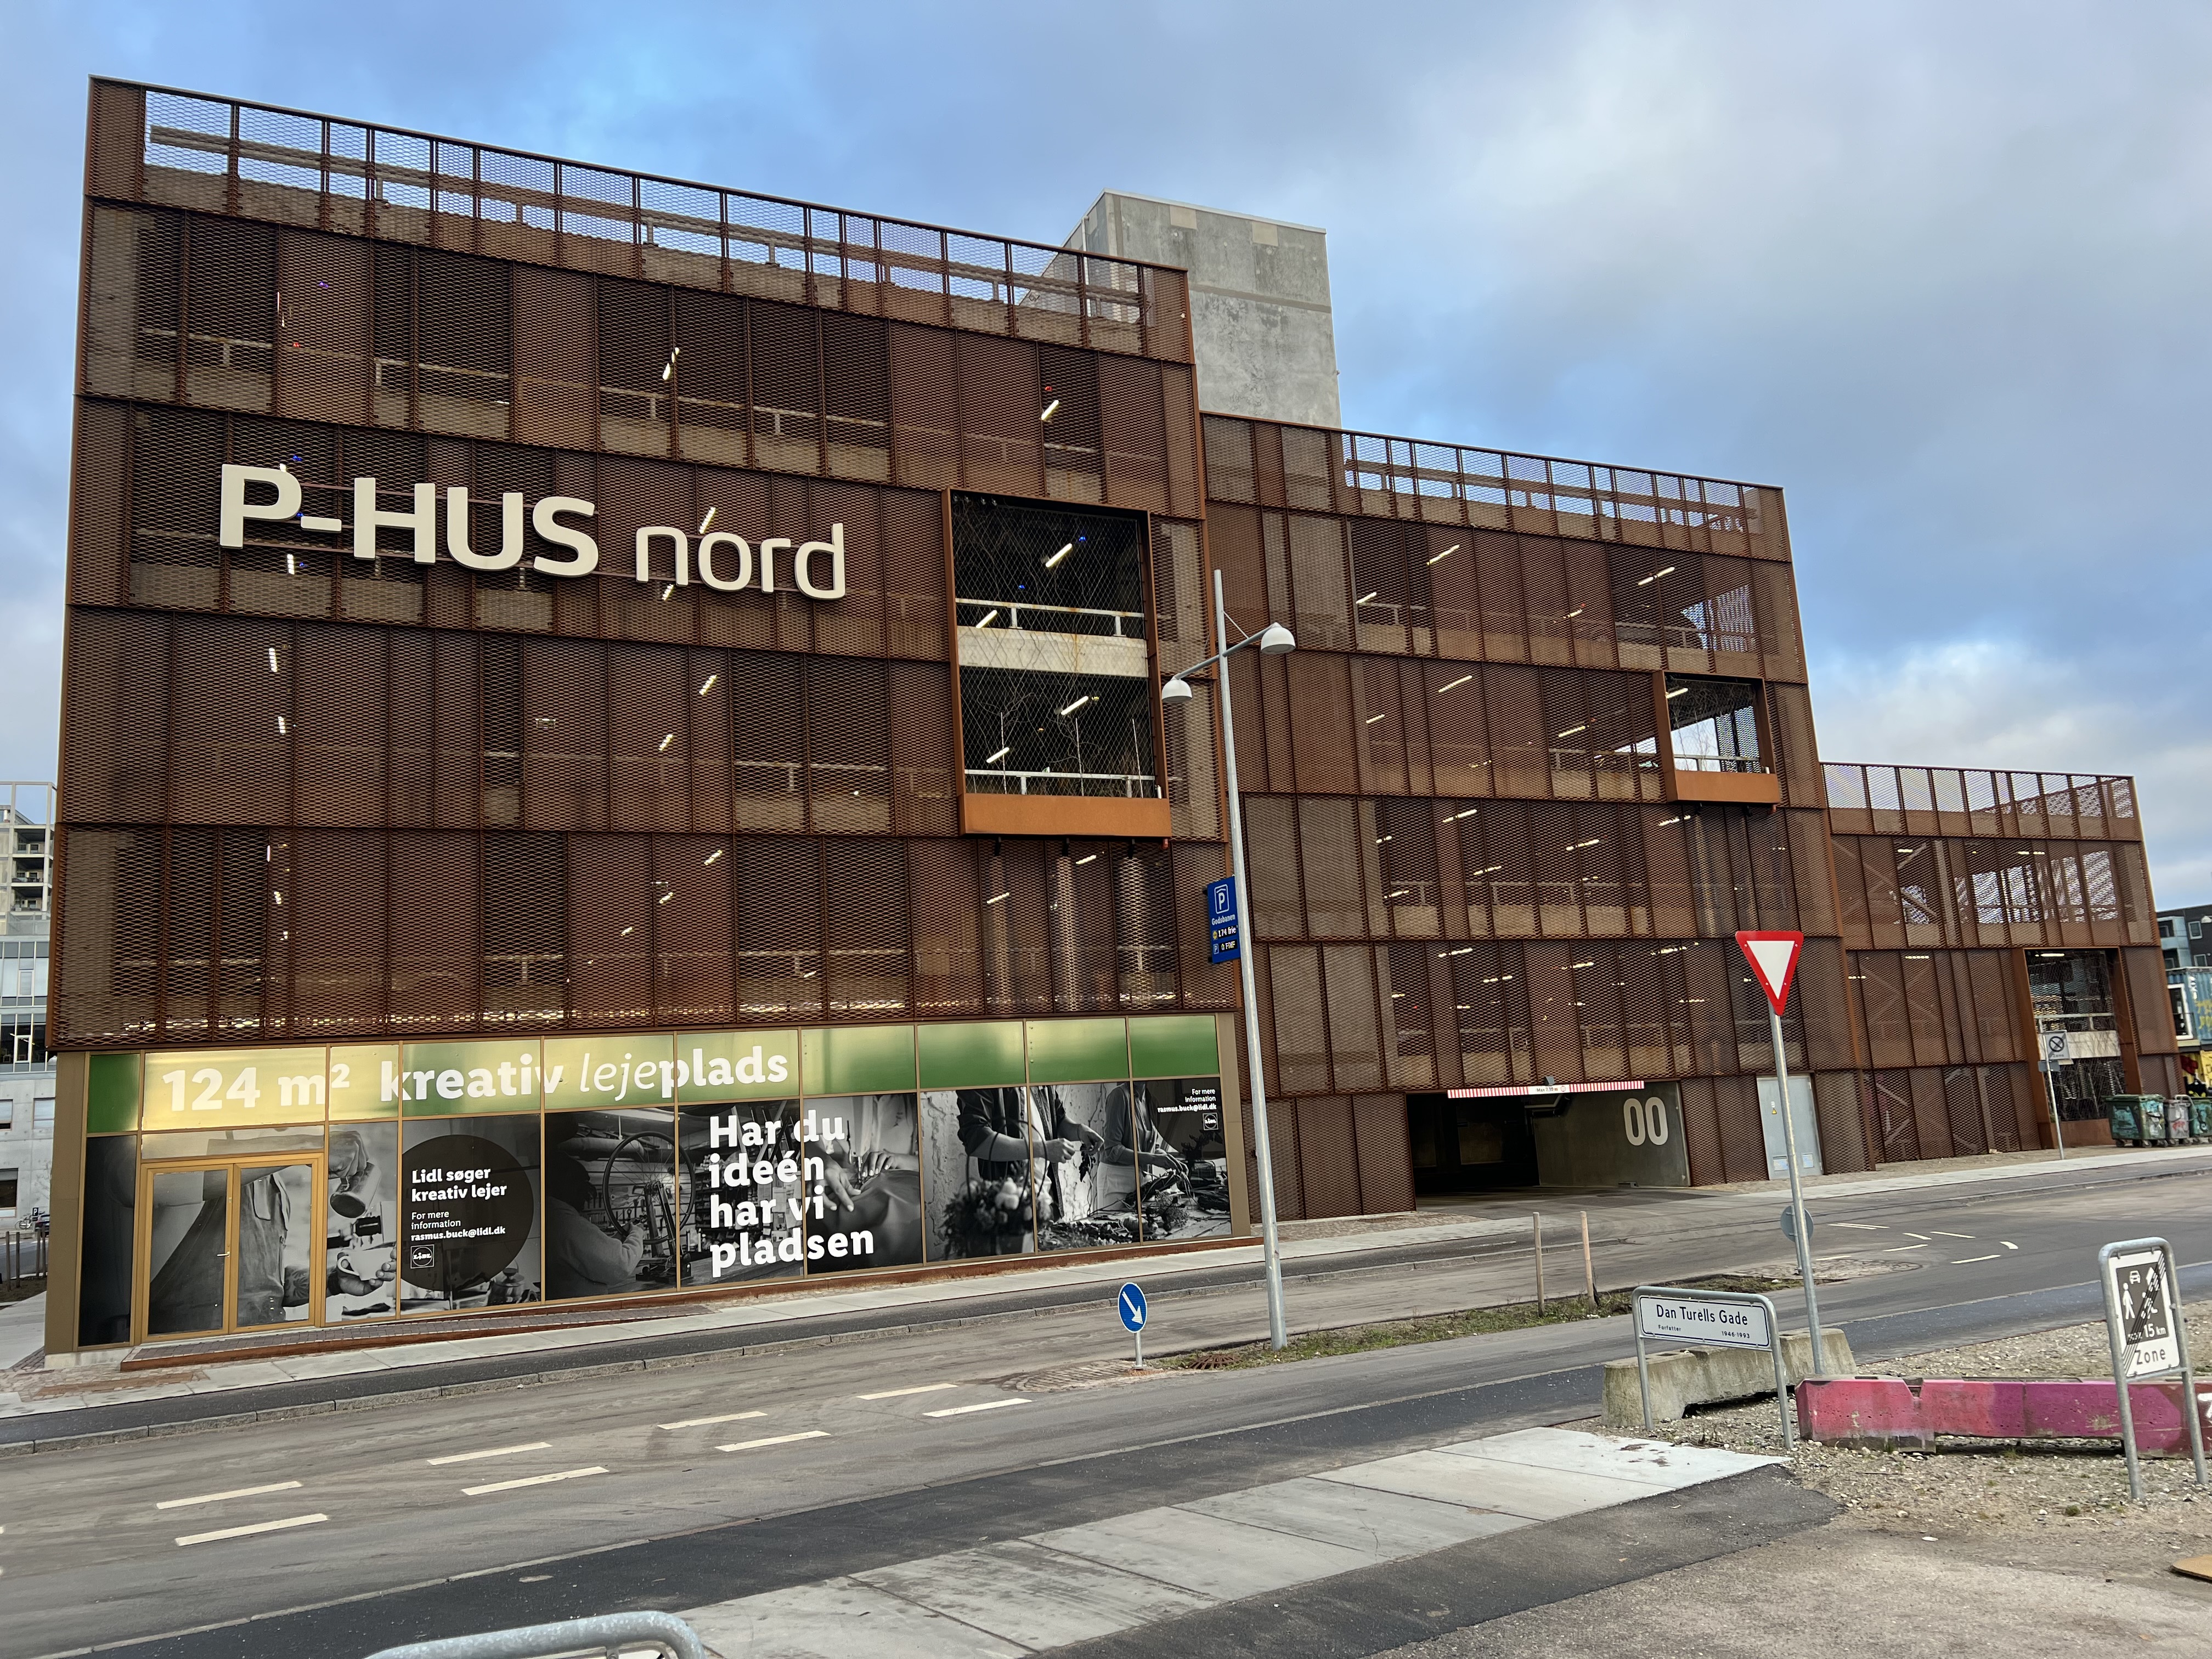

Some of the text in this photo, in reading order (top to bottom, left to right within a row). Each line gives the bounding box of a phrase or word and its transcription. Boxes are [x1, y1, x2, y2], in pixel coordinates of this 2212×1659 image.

[220, 463, 846, 600] P-HUS nord
[1211, 914, 1235, 926] Godsbanen
[1218, 928, 1227, 937] 174
[162, 1067, 261, 1112] 124
[380, 1053, 564, 1102] kreativ
[579, 1046, 788, 1102] lejeplads
[1157, 1103, 1217, 1113] rasmus.buck@lidl.dk
[710, 1109, 845, 1148] Har du
[1623, 1097, 1668, 1147] 00
[412, 1168, 491, 1183] Lidl søger
[709, 1150, 824, 1188] ideén
[411, 1183, 507, 1201] kreativ lejer
[710, 1185, 823, 1228] har vi
[411, 1220, 461, 1229] information
[411, 1226, 506, 1241] rasmus.buck@lidl.dk
[710, 1227, 874, 1278] pladsen
[1656, 1304, 1677, 1318] Dan
[1719, 1310, 1748, 1325] Gade
[1722, 1330, 1750, 1339] 1946-1993
[2144, 1323, 2155, 1338] 15
[2156, 1326, 2166, 1335] km
[2135, 1348, 2166, 1365] Zone
